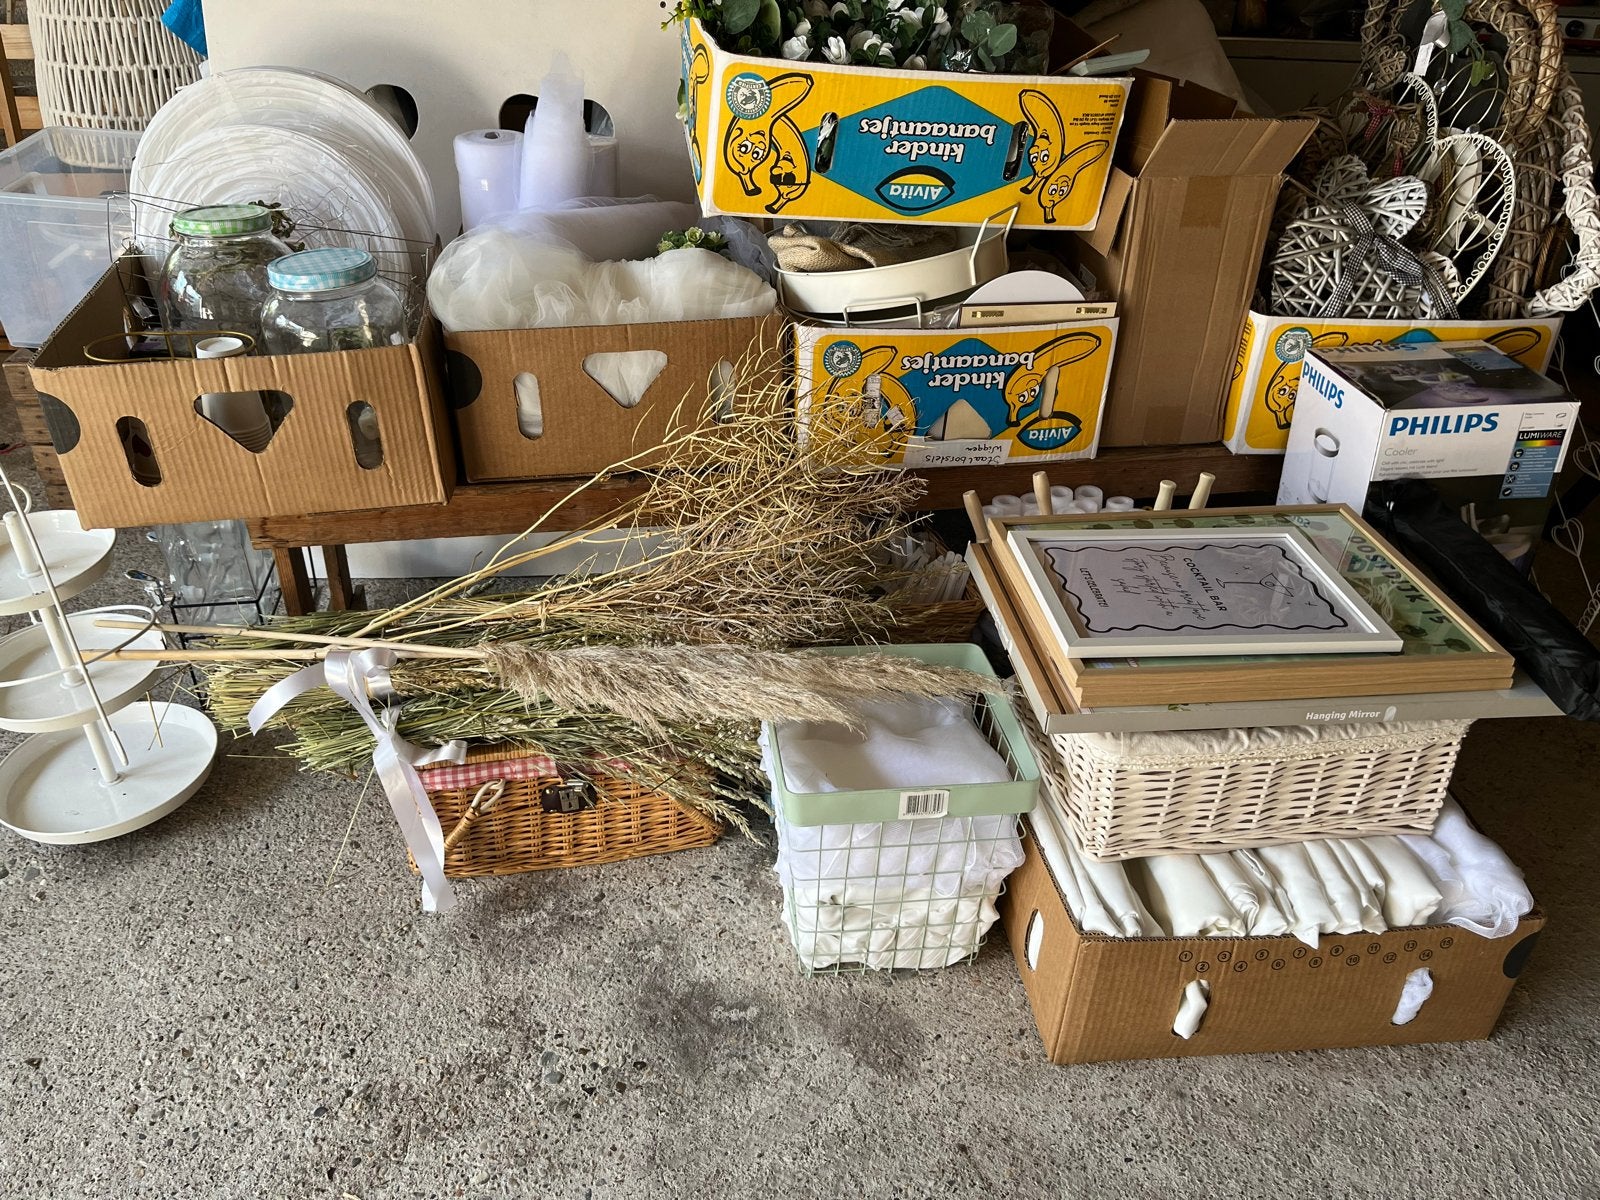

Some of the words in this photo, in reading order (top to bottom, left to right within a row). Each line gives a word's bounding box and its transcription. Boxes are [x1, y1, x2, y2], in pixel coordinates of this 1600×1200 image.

[859, 115, 997, 145] banaantjes
[884, 140, 965, 163] kinder
[889, 184, 943, 200] Alvita
[901, 351, 1036, 375] banaantjes
[929, 371, 1006, 392] kinder
[1302, 361, 1345, 409] PHILIPS
[1028, 426, 1074, 441] Alvita
[1389, 412, 1500, 437] PHILIPS
[1518, 432, 1563, 440] LUMIWARE
[1384, 447, 1419, 457] Cooler
[1183, 557, 1214, 593] COCKTAIL
[1210, 595, 1228, 612] BAR
[1422, 608, 1453, 625] 15
[1305, 711, 1347, 721] Hanging
[1348, 709, 1381, 719] Mirror
